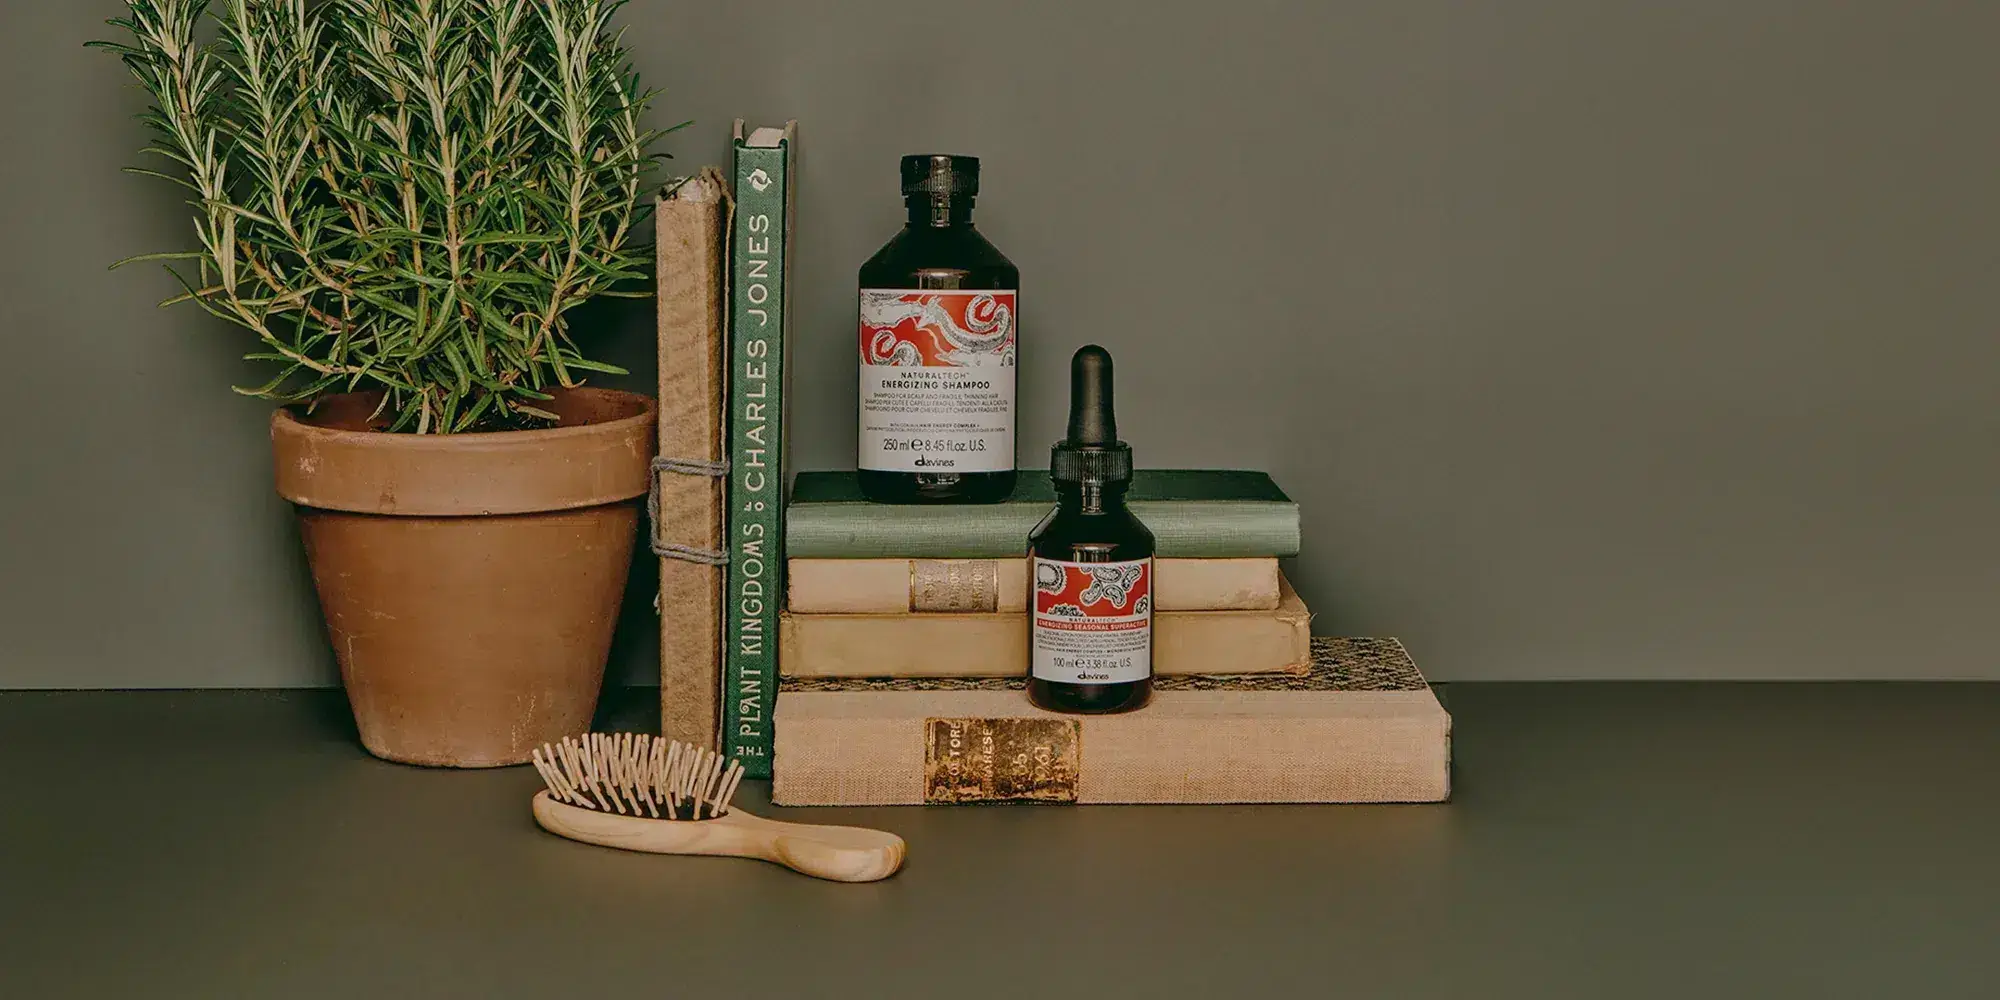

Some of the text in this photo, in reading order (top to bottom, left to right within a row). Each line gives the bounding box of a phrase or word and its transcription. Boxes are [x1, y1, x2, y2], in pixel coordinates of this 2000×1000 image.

[881, 380, 991, 390] ENERGIZING SHAMPOO
[883, 438, 898, 451] 250
[899, 439, 910, 451] ml
[925, 440, 945, 451] 8.45
[969, 438, 987, 451] U.S.
[914, 454, 955, 467] davines
[736, 214, 770, 756] THE PLANT KINGDOMS OF CHARLES JONES
[1038, 619, 1073, 630] ENERGIZING
[1110, 619, 1147, 630] SUPERACTIVE
[1053, 657, 1065, 668] 100
[1066, 657, 1074, 668] ml
[1086, 658, 1101, 669] 3.38
[1077, 670, 1109, 680] davines
